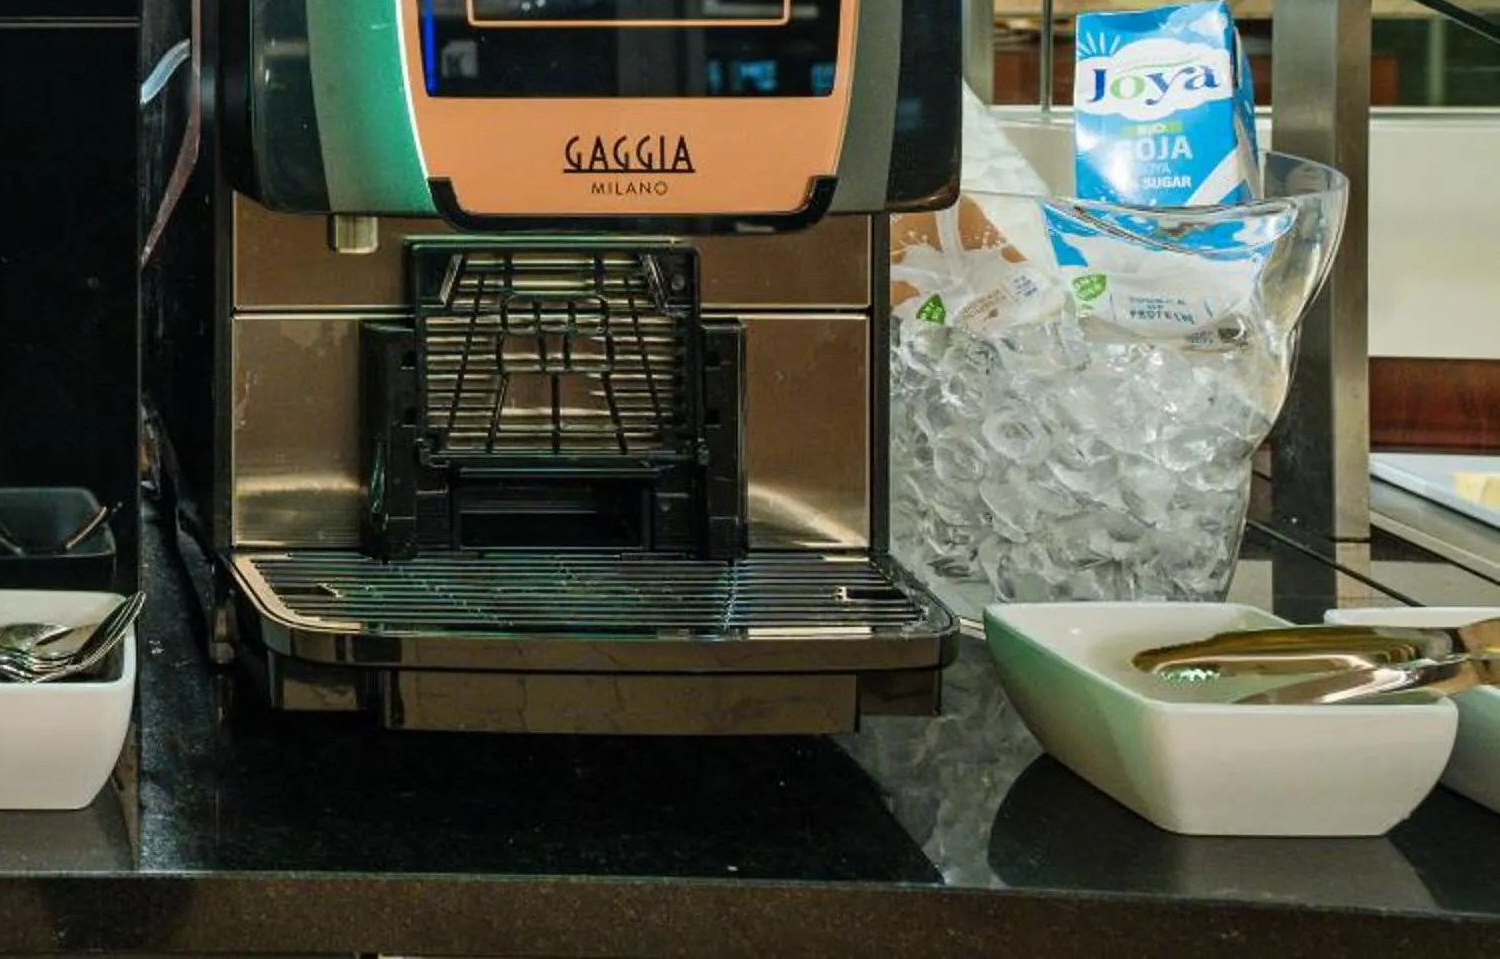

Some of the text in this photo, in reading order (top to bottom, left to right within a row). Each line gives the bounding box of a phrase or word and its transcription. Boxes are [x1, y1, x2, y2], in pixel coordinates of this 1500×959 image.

[1087, 65, 1219, 105] Joya
[564, 135, 695, 173] GAGGIA
[591, 181, 668, 196] MILANO
[1140, 175, 1192, 188] SUGAR
